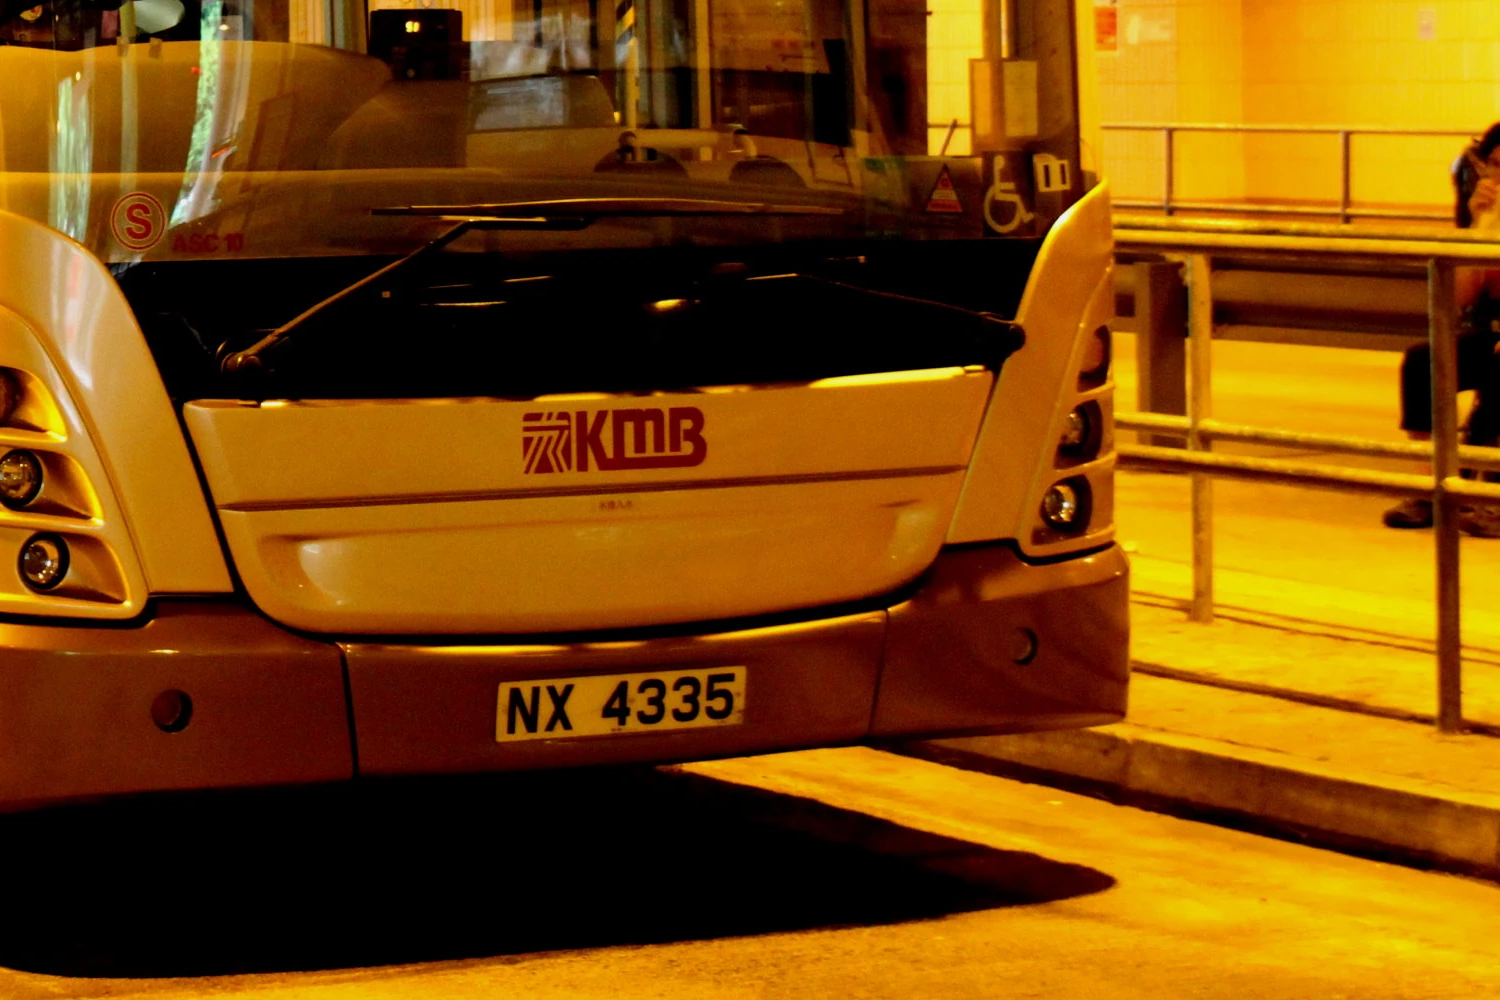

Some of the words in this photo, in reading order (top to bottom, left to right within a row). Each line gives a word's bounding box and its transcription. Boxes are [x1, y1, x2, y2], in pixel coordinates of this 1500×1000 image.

[125, 202, 153, 240] S
[171, 232, 220, 254] ASC
[575, 405, 708, 473] KMB
[505, 683, 576, 735] NX
[601, 672, 737, 727] 4335
